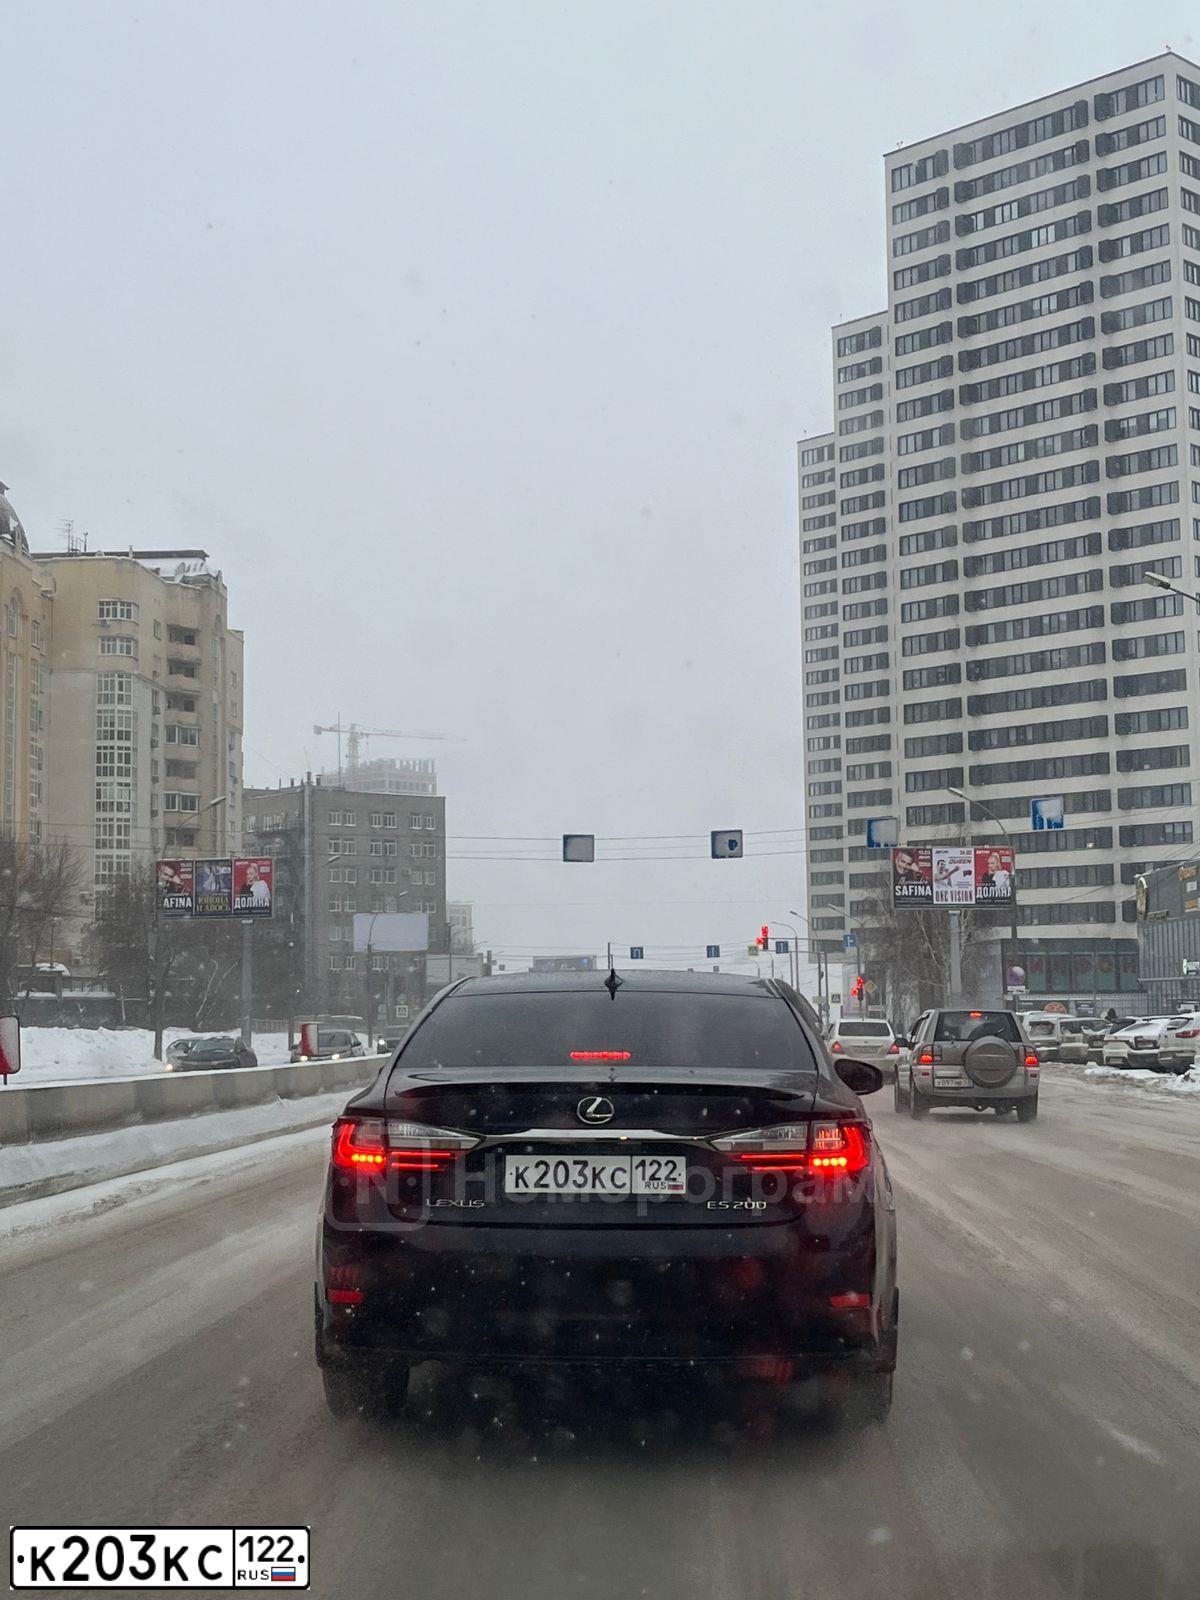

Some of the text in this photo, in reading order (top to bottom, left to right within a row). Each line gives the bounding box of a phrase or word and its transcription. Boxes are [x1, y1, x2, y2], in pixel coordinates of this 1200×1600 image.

[895, 885, 932, 896] SAFINA
[950, 890, 973, 902] VISION
[163, 896, 192, 908] AFINA
[234, 896, 270, 909] ДОЛИНА
[514, 1158, 678, 1189] К203КС 122
[644, 1181, 667, 1190] RUS
[425, 1198, 486, 1210] LEXUS
[706, 1200, 767, 1210] ES 200
